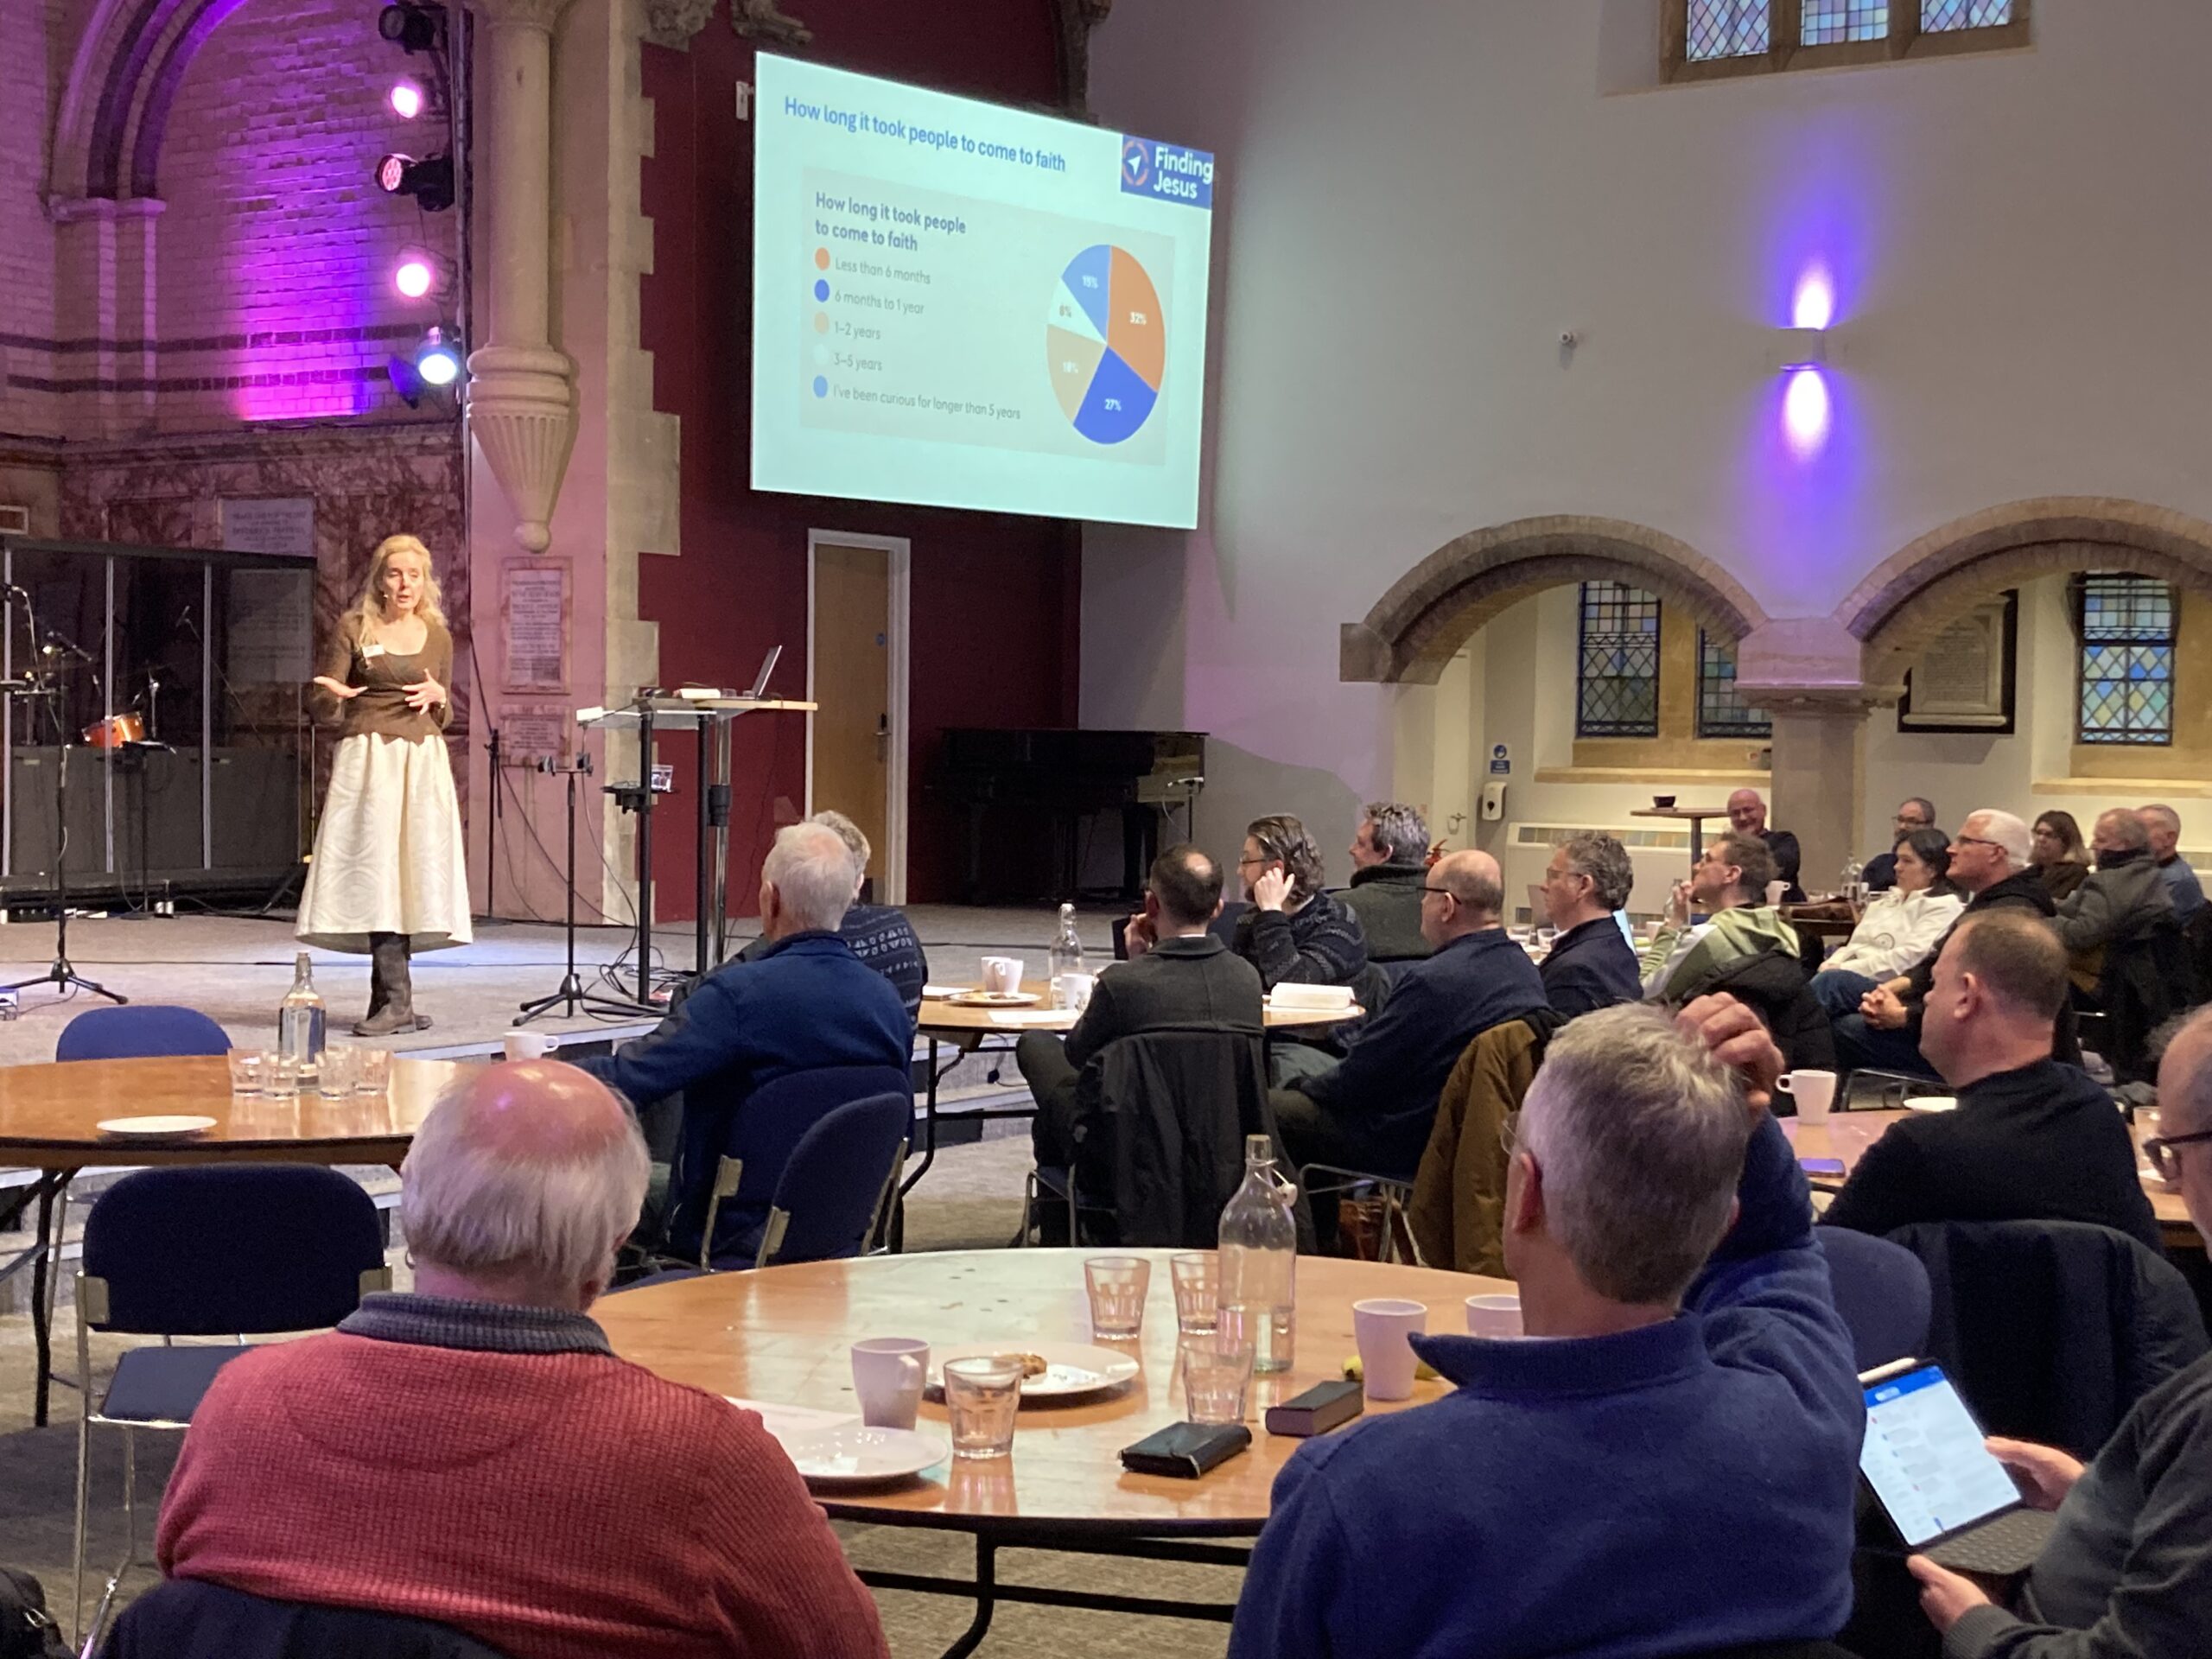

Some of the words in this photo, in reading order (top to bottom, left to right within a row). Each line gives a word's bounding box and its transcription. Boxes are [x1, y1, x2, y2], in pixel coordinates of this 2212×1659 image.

[785, 96, 821, 120] How
[823, 105, 857, 133] long
[860, 111, 869, 130] it
[873, 116, 906, 139] took
[909, 126, 958, 150] people
[961, 135, 976, 153] to
[978, 142, 1017, 162] come
[1020, 147, 1033, 165] to
[1036, 149, 1065, 172] faith
[1155, 146, 1213, 184] Finding
[1154, 170, 1198, 199] Jesus
[816, 192, 845, 212] How
[849, 197, 877, 221] long
[880, 203, 890, 220] it
[893, 207, 921, 226] took
[925, 215, 966, 235] people
[816, 219, 829, 235] to
[832, 225, 868, 242] come
[872, 229, 885, 245] to
[888, 231, 918, 251] faith
[836, 257, 857, 273] Less
[860, 261, 883, 276] than
[885, 265, 892, 278] 6
[893, 270, 931, 284] months
[835, 290, 842, 302] 6
[843, 293, 881, 308] months
[884, 297, 894, 310] to
[897, 298, 901, 311] 1
[903, 302, 925, 315] year
[853, 327, 881, 340] years
[855, 358, 882, 372] years
[853, 387, 878, 402] been
[880, 392, 916, 407] curious
[918, 394, 931, 408] for
[933, 396, 963, 415] longer
[965, 401, 987, 415] than
[988, 404, 995, 416] 5
[996, 408, 1020, 420] years
[1104, 398, 1122, 412] 27%
